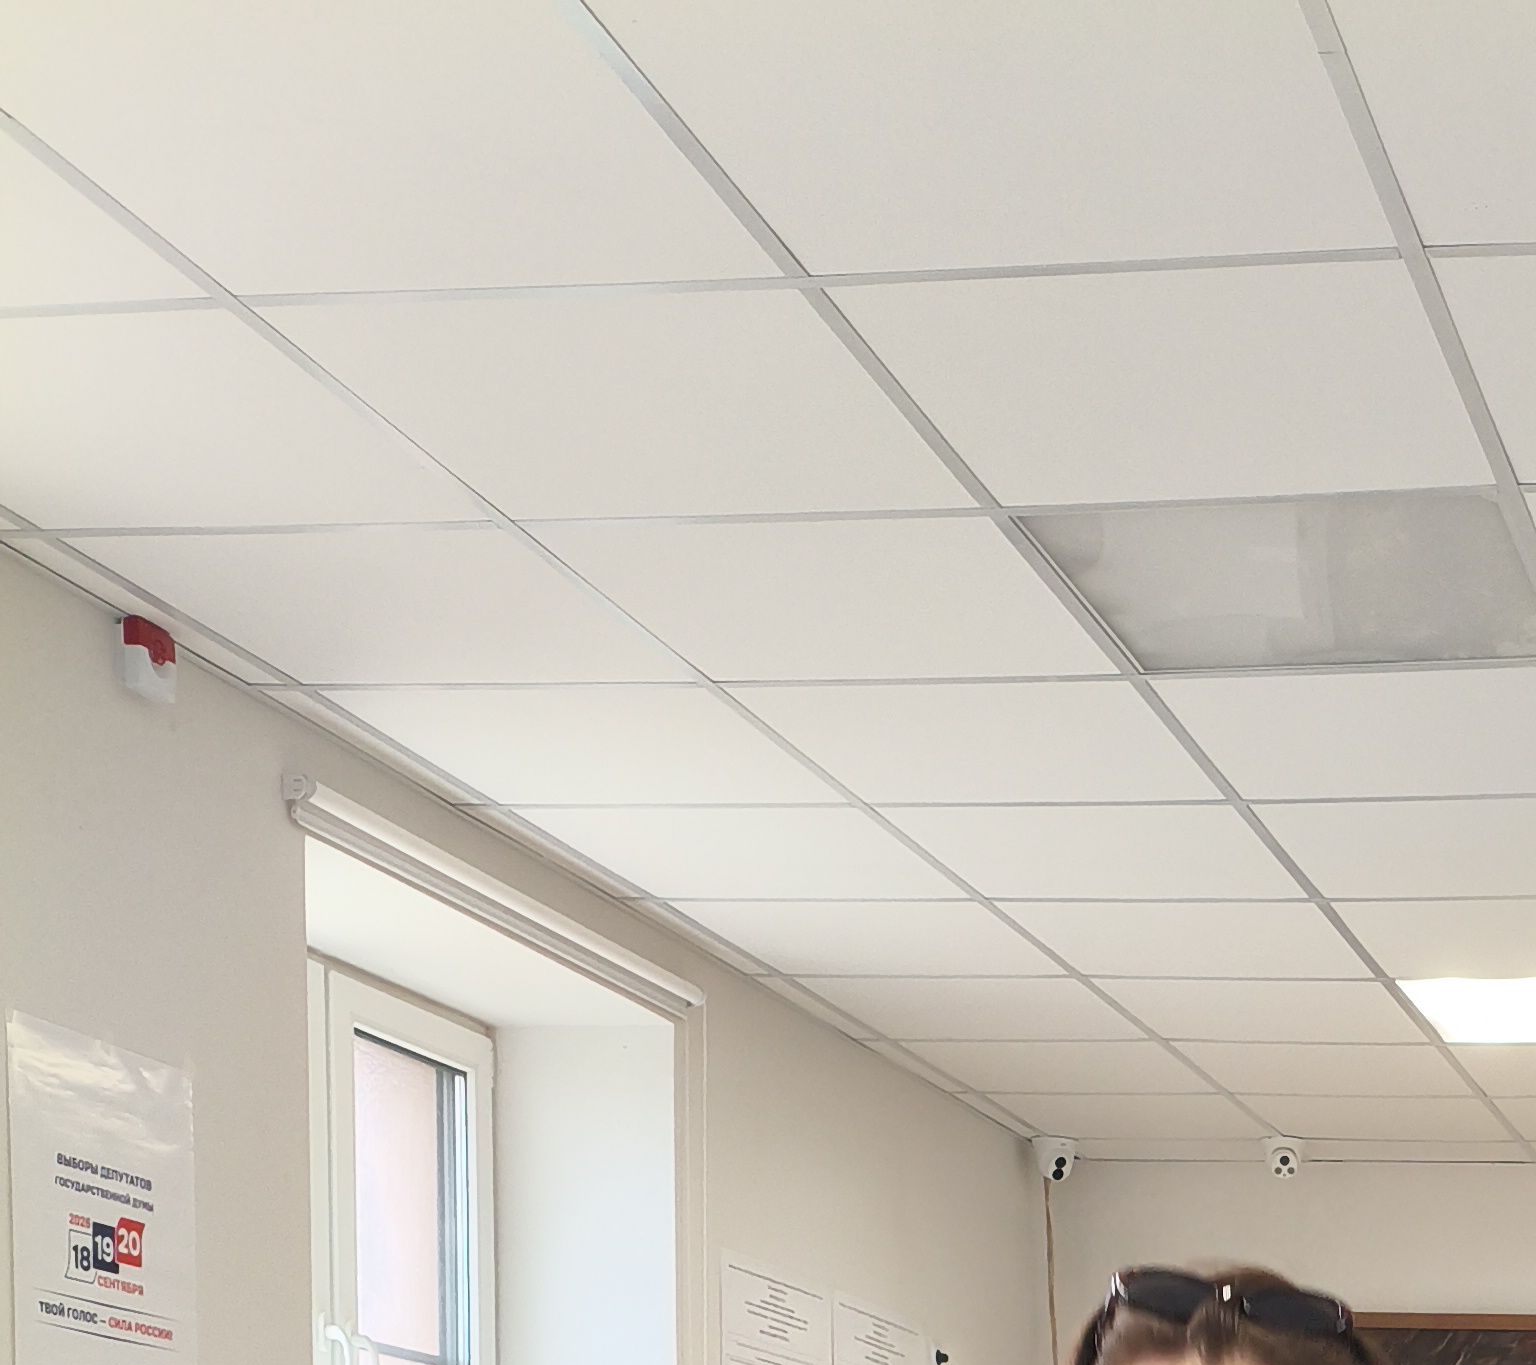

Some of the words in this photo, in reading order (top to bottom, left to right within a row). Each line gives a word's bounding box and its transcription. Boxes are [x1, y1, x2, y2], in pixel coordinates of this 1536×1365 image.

[57, 1153, 98, 1175] ВЫБОРЫ
[100, 1166, 152, 1191] ДЕПУТАТОВ
[55, 1176, 130, 1205] ГОСУДАРСТВЕННОЙ
[73, 1244, 91, 1271] 18
[95, 1235, 113, 1262] 19
[118, 1228, 140, 1256] 20
[97, 1276, 144, 1296] СЕНТЯБРЯ
[39, 1301, 65, 1317] ТВОЙ
[67, 1308, 98, 1324] ГОЛОС
[108, 1317, 132, 1331] СИЛА
